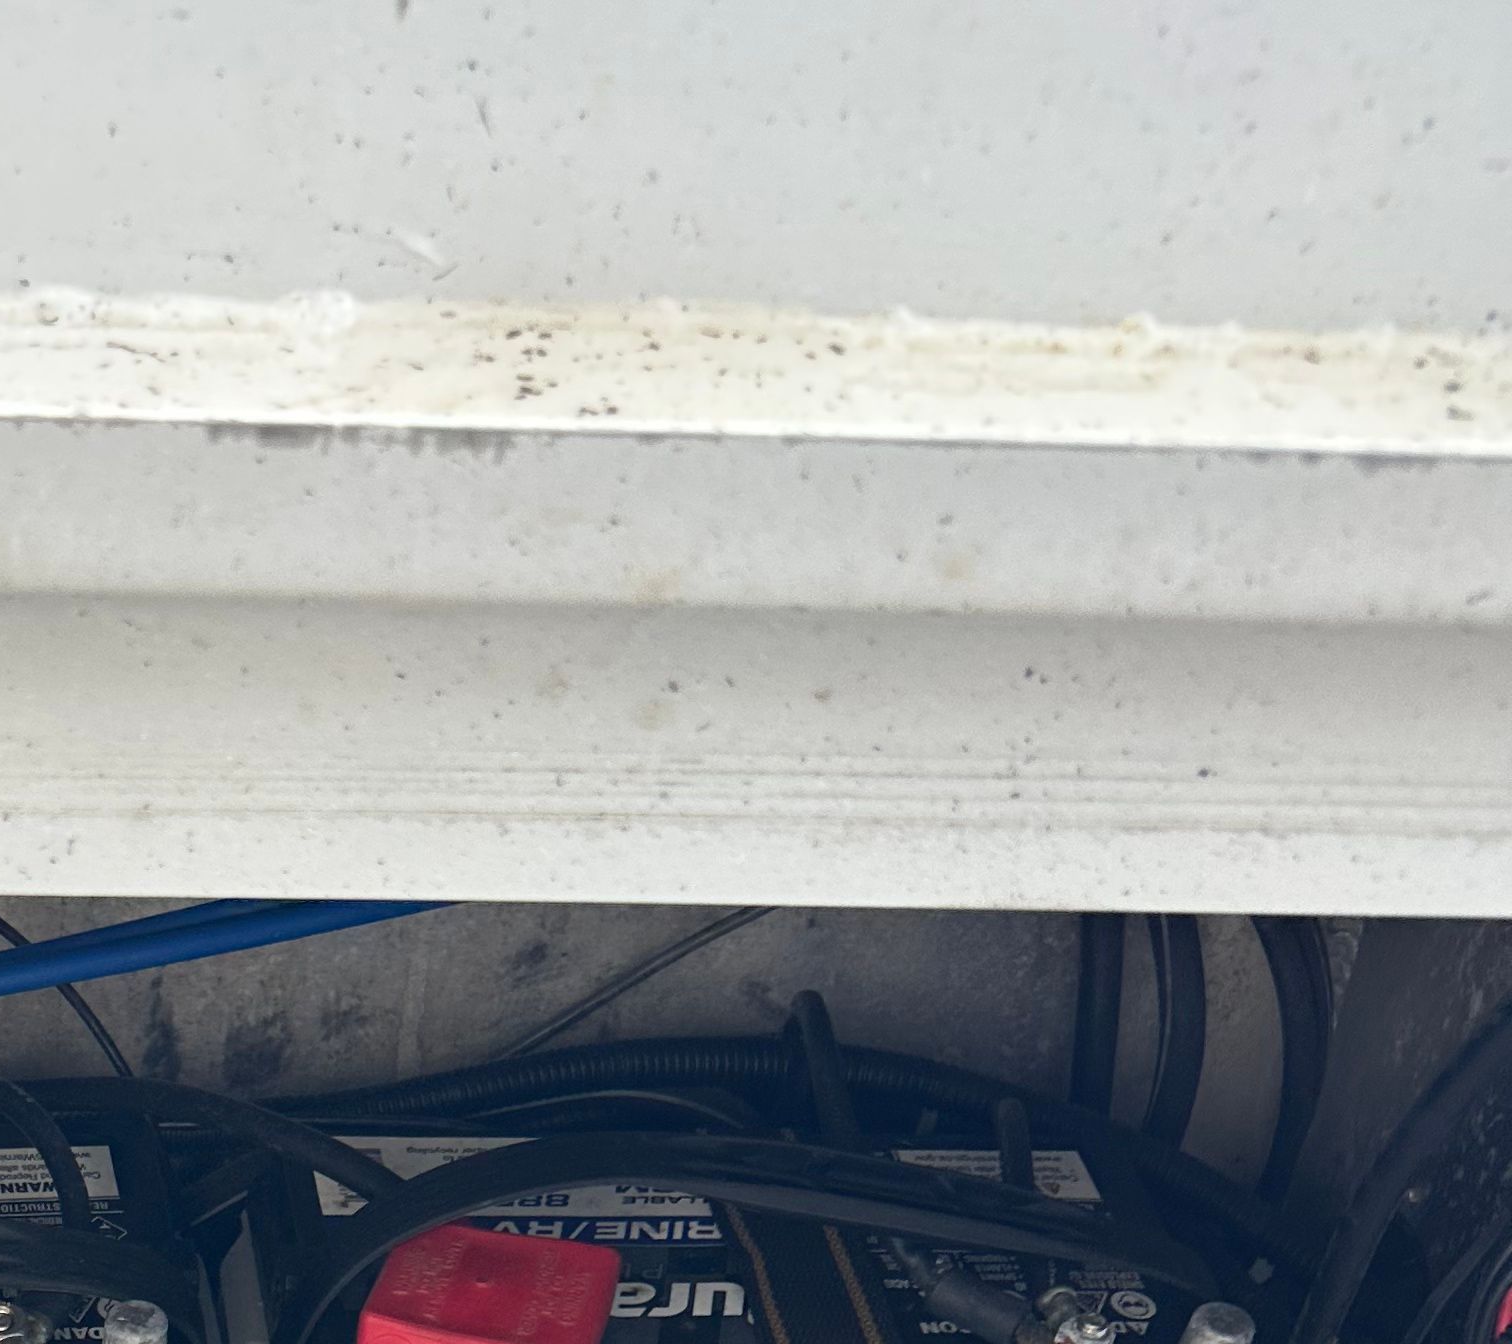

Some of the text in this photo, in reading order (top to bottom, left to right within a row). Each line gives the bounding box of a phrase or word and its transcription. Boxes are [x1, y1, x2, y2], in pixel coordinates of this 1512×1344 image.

[490, 1220, 722, 1240] RINE/RV
[610, 1282, 746, 1317] ura
[54, 1326, 104, 1340] DAN
